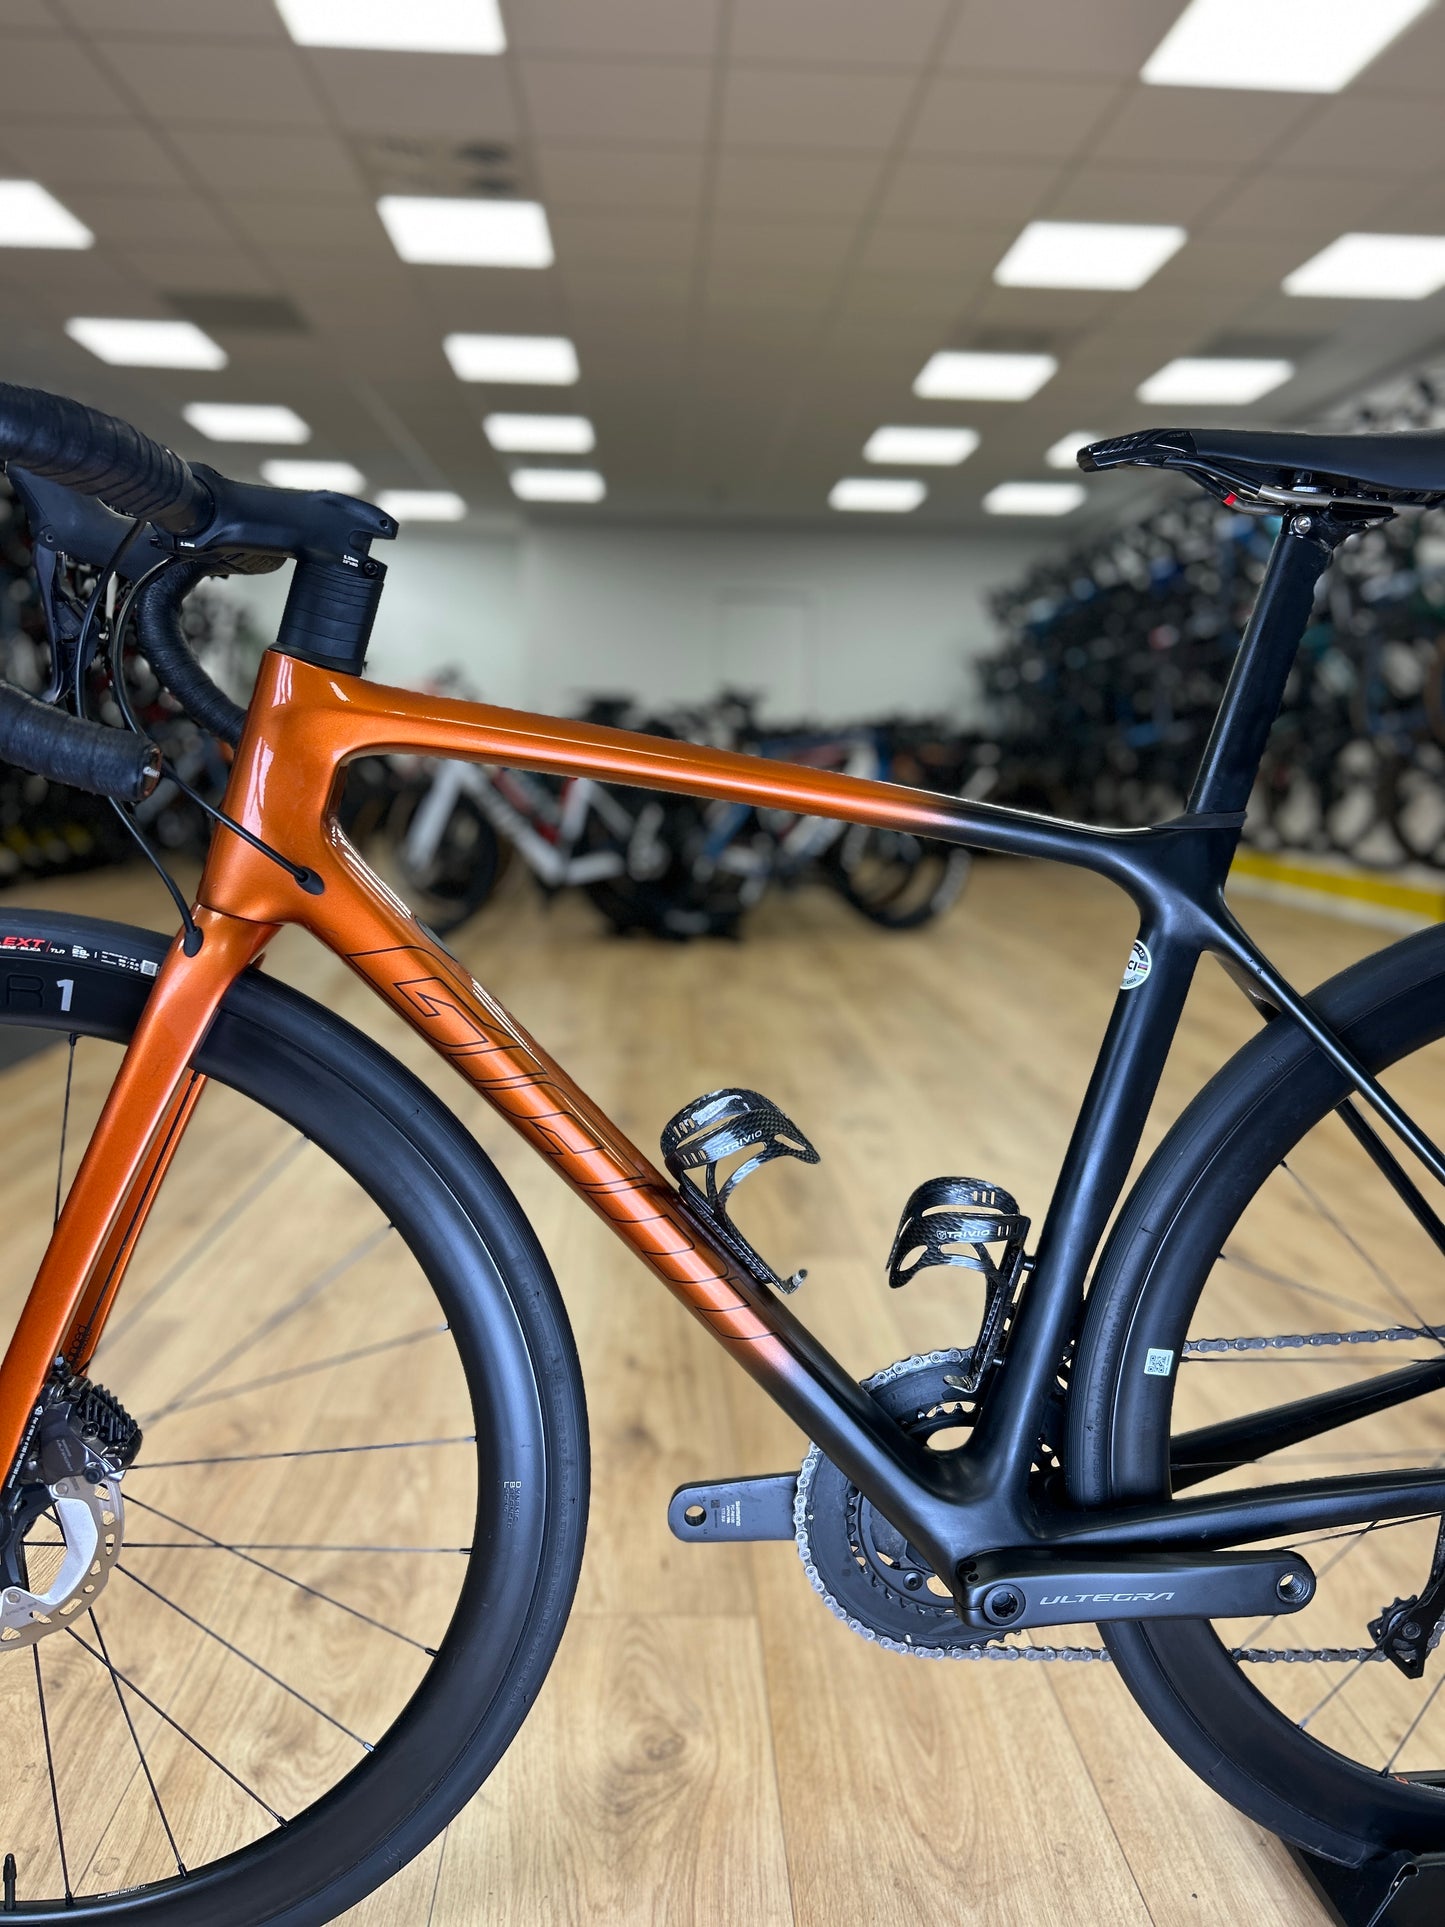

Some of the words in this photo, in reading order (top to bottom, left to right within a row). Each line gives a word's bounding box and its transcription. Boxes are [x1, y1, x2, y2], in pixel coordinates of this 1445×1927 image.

[1127, 960, 1138, 971] CI
[56, 979, 74, 1012] 1
[346, 945, 825, 1368] GIANT
[947, 1229, 990, 1240] TRIVIO
[1040, 1592, 1175, 1605] ULTEGRA
